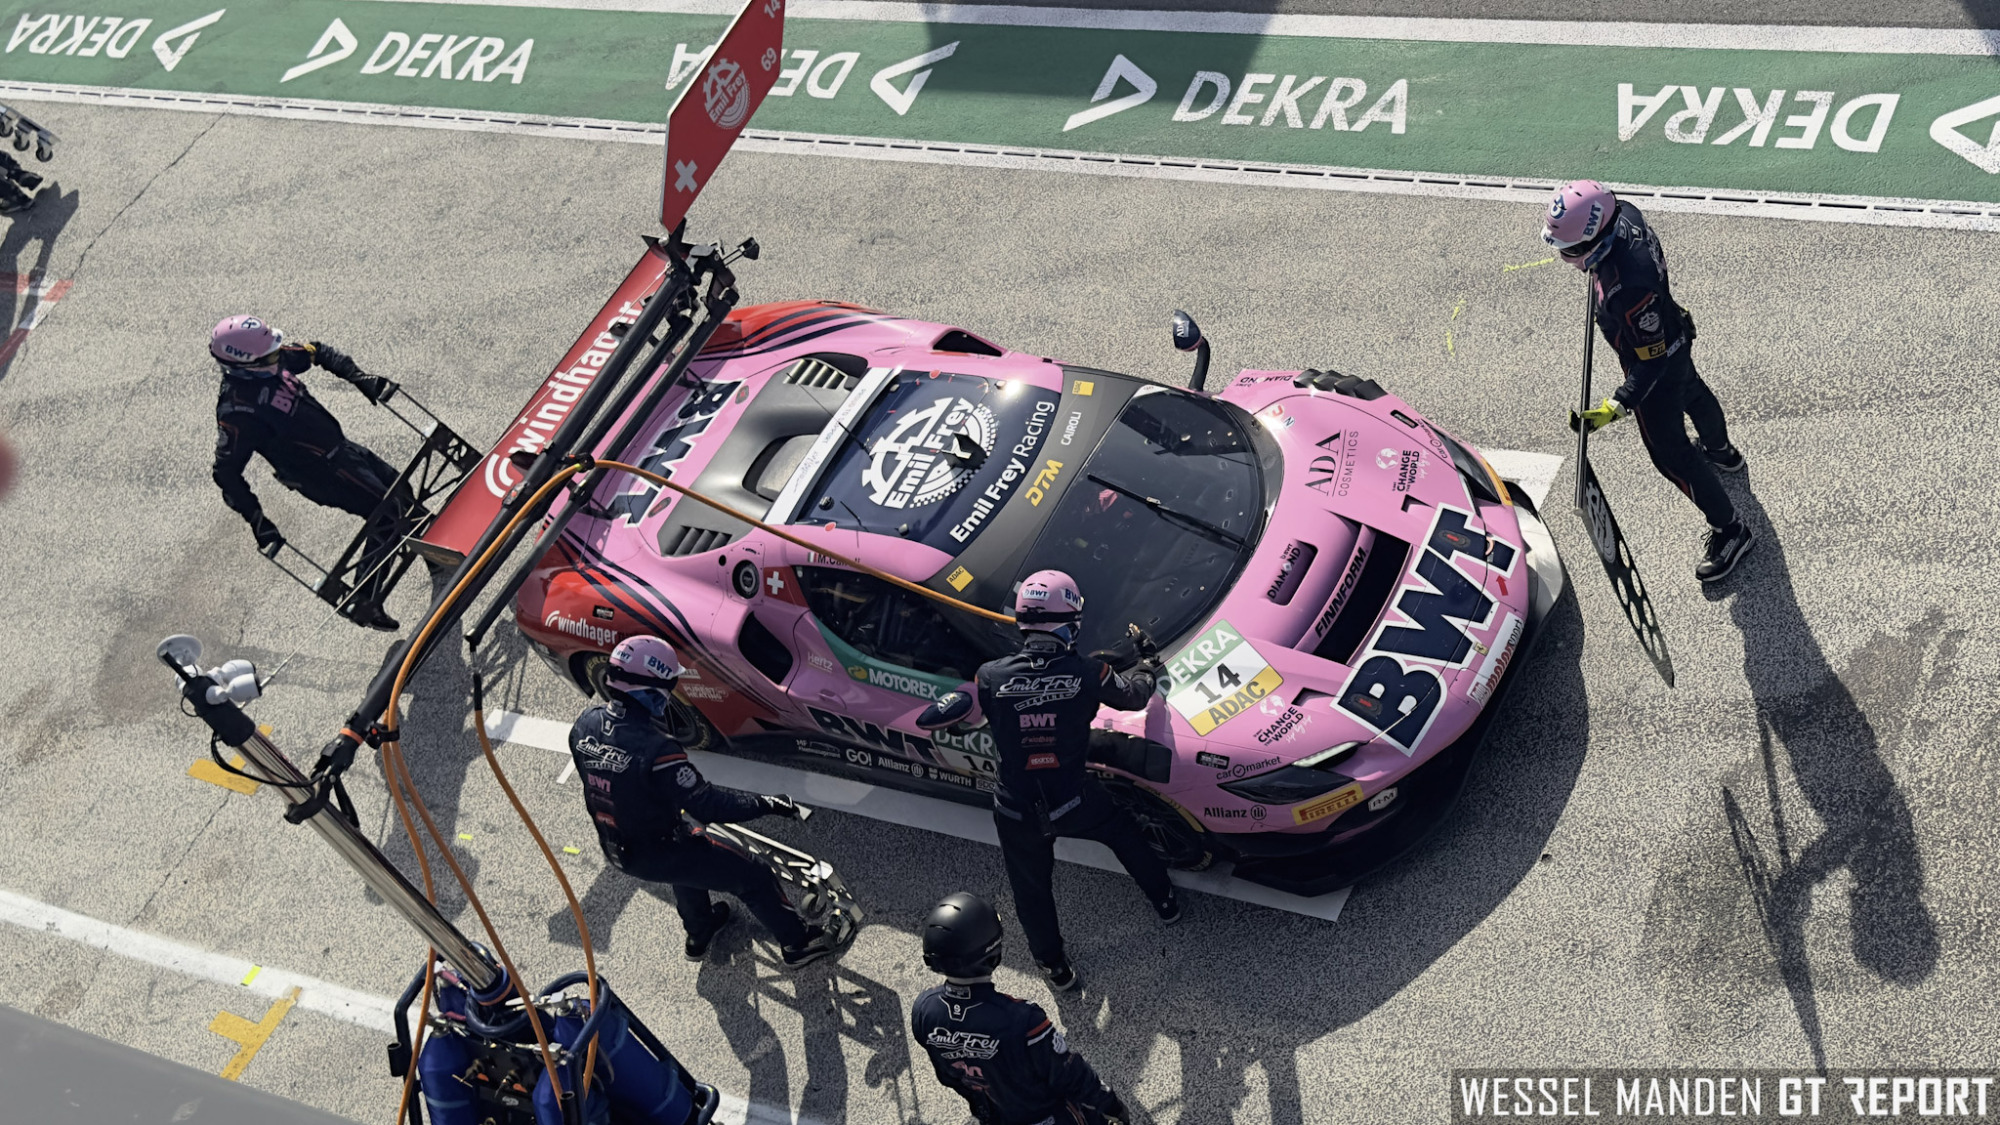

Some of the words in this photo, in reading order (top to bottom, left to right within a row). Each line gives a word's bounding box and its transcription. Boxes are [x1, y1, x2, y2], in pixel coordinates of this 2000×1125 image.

[5, 13, 153, 58] DEKRA
[360, 30, 535, 84] DEKRA
[761, 48, 777, 71] 69
[709, 93, 728, 123] Emil
[726, 70, 746, 98] Frey
[1172, 70, 1409, 135] DEKRA
[1617, 83, 1900, 153] DEKRA
[1584, 201, 1601, 236] BWT
[225, 344, 252, 361] BWT
[1060, 411, 1082, 447] CAIROLI
[884, 452, 936, 509] Emil
[926, 397, 975, 450] Frey
[1304, 431, 1343, 497] ADA
[1338, 430, 1360, 497] COSMETICS
[1408, 451, 1420, 484] WORLD
[949, 498, 995, 544] Emil
[986, 459, 1027, 502] Frey
[1011, 401, 1056, 461] Racing
[1024, 459, 1065, 508] DTM
[1397, 450, 1411, 492] CHANGE
[1029, 590, 1048, 598] BWT
[1314, 546, 1368, 639] FINNFORM
[557, 615, 618, 647] windhager
[1329, 502, 1521, 758] BWT
[647, 656, 673, 678] BWT
[807, 652, 833, 670] Hertz
[1156, 628, 1238, 697] DEKRA
[869, 668, 938, 701] MOTOREX
[1000, 677, 1041, 692] Emil
[1041, 675, 1082, 696] Frey
[1195, 663, 1242, 705] 14
[1019, 713, 1057, 728] BWT
[1208, 680, 1266, 726] ADAC
[1258, 706, 1298, 743] CHANGE
[1272, 713, 1304, 742] WORLD
[577, 735, 605, 753] Emil
[600, 744, 633, 767] Frey
[846, 748, 872, 766] GO!
[878, 756, 910, 772] Allianz
[587, 774, 611, 793] BWT
[1203, 806, 1248, 819] Allianz
[1299, 790, 1359, 821] PIRELLI
[928, 1027, 961, 1044] Emil
[960, 1032, 999, 1052] Frey
